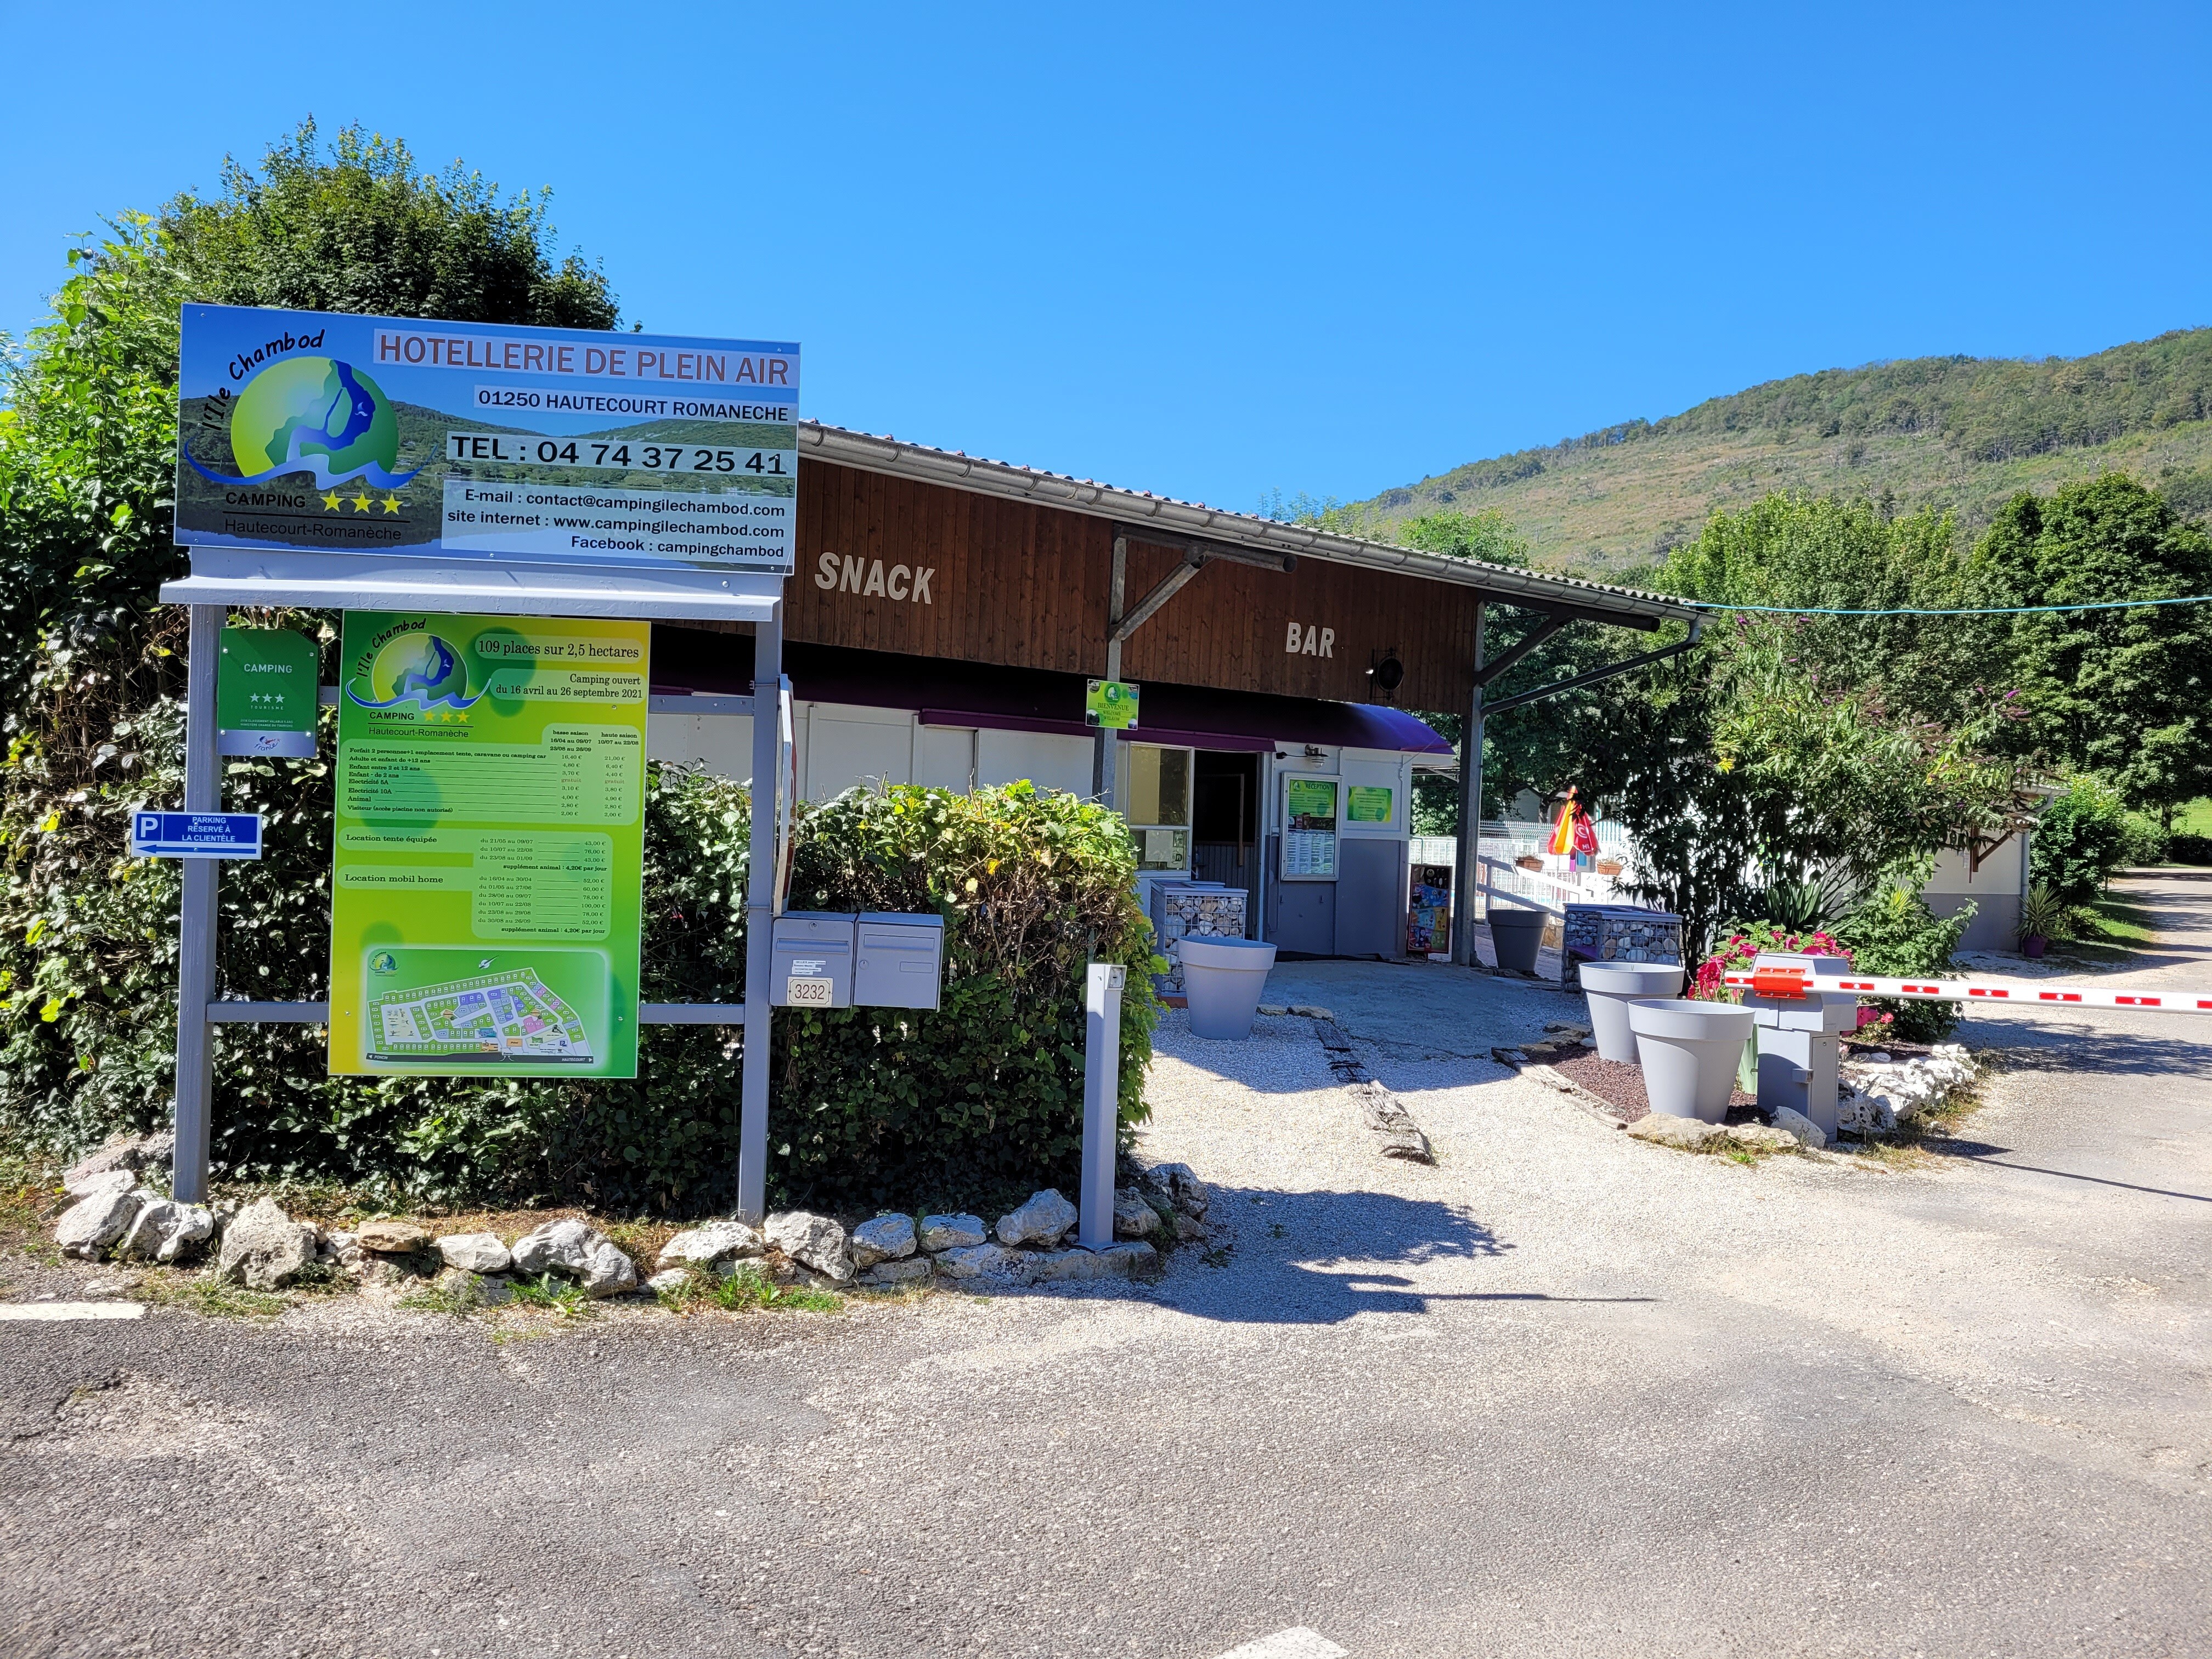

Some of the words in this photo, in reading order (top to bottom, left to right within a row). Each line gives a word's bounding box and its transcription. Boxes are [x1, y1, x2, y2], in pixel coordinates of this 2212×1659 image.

[381, 335, 574, 373] HOTELLERIE
[586, 348, 626, 375] DE
[637, 351, 725, 381] PLEIN
[736, 358, 788, 385] AIR
[202, 387, 230, 431] l'Ile
[229, 329, 325, 380] Chambod
[479, 391, 540, 407] 01250
[547, 394, 668, 414] HAUTECOURT
[674, 402, 788, 421] ROMANECHE
[452, 436, 509, 460] TEL
[520, 446, 526, 461] :
[538, 441, 579, 464] 04
[591, 444, 631, 466] 74
[642, 447, 683, 469] 37
[694, 450, 735, 472] 25
[745, 452, 787, 475] 41
[225, 492, 306, 507] CAMPING
[466, 489, 512, 503] E-mail
[518, 495, 521, 503] :
[527, 494, 785, 516] contact@campingilechambod.com
[225, 518, 402, 540] Hautecourt-Romanèche
[448, 510, 475, 522] site
[481, 511, 540, 526] internet
[554, 517, 784, 537] www.campingilechambod.com
[572, 536, 645, 551] Facebook
[658, 543, 783, 557] campingchambod
[815, 552, 936, 604] SNACK
[357, 652, 373, 677] l'Ile
[372, 618, 426, 648] Chambod
[479, 640, 500, 653] 109
[503, 641, 540, 656] places
[544, 646, 564, 655] sur
[567, 644, 585, 658] 2,5
[589, 644, 639, 658] hectares
[1286, 622, 1335, 658] BAR
[244, 663, 292, 674] CAMPING
[570, 674, 610, 686] Camping
[496, 684, 507, 693] du
[511, 685, 521, 694] 16
[523, 686, 544, 695] avril
[561, 687, 571, 696] 26
[574, 688, 619, 698] septembre
[622, 689, 642, 698] 2021
[1098, 702, 1129, 711] BIENVENUE
[369, 727, 469, 737] Hautecourt-Romanèche
[140, 817, 159, 838] P
[188, 824, 223, 833] RÉSERVÉ
[225, 825, 230, 833] À
[194, 833, 235, 842] CLIENTÈLE
[794, 984, 825, 1000] 3232
